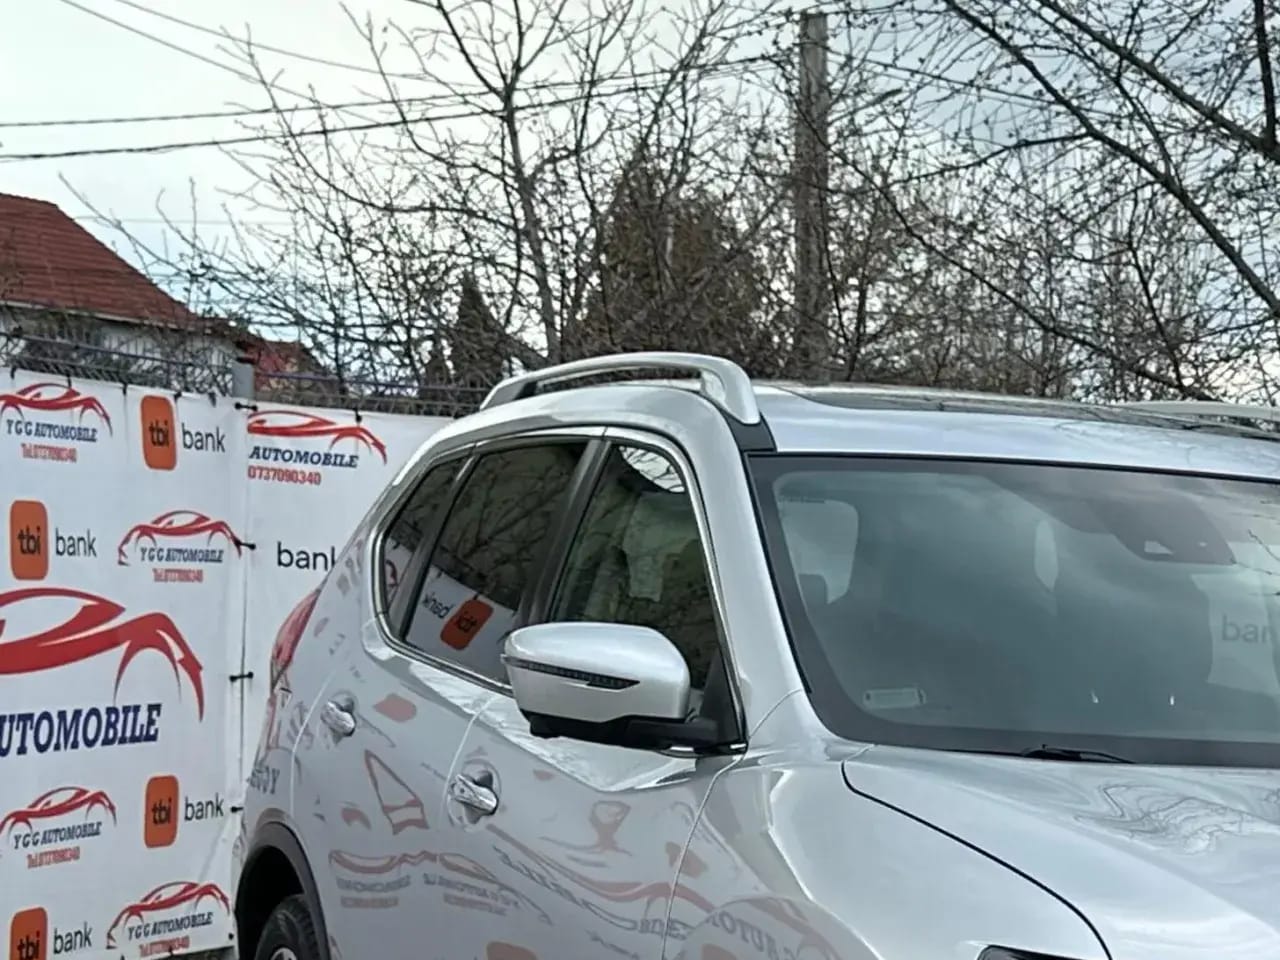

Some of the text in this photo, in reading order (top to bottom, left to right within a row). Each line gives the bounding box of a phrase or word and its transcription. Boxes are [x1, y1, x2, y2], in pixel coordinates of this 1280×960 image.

[148, 422, 226, 453] tbi bank
[248, 445, 359, 468] AUTOMOBILE
[18, 524, 97, 557] tbi bank
[151, 792, 225, 825] tbi bank
[53, 921, 93, 954] bank
